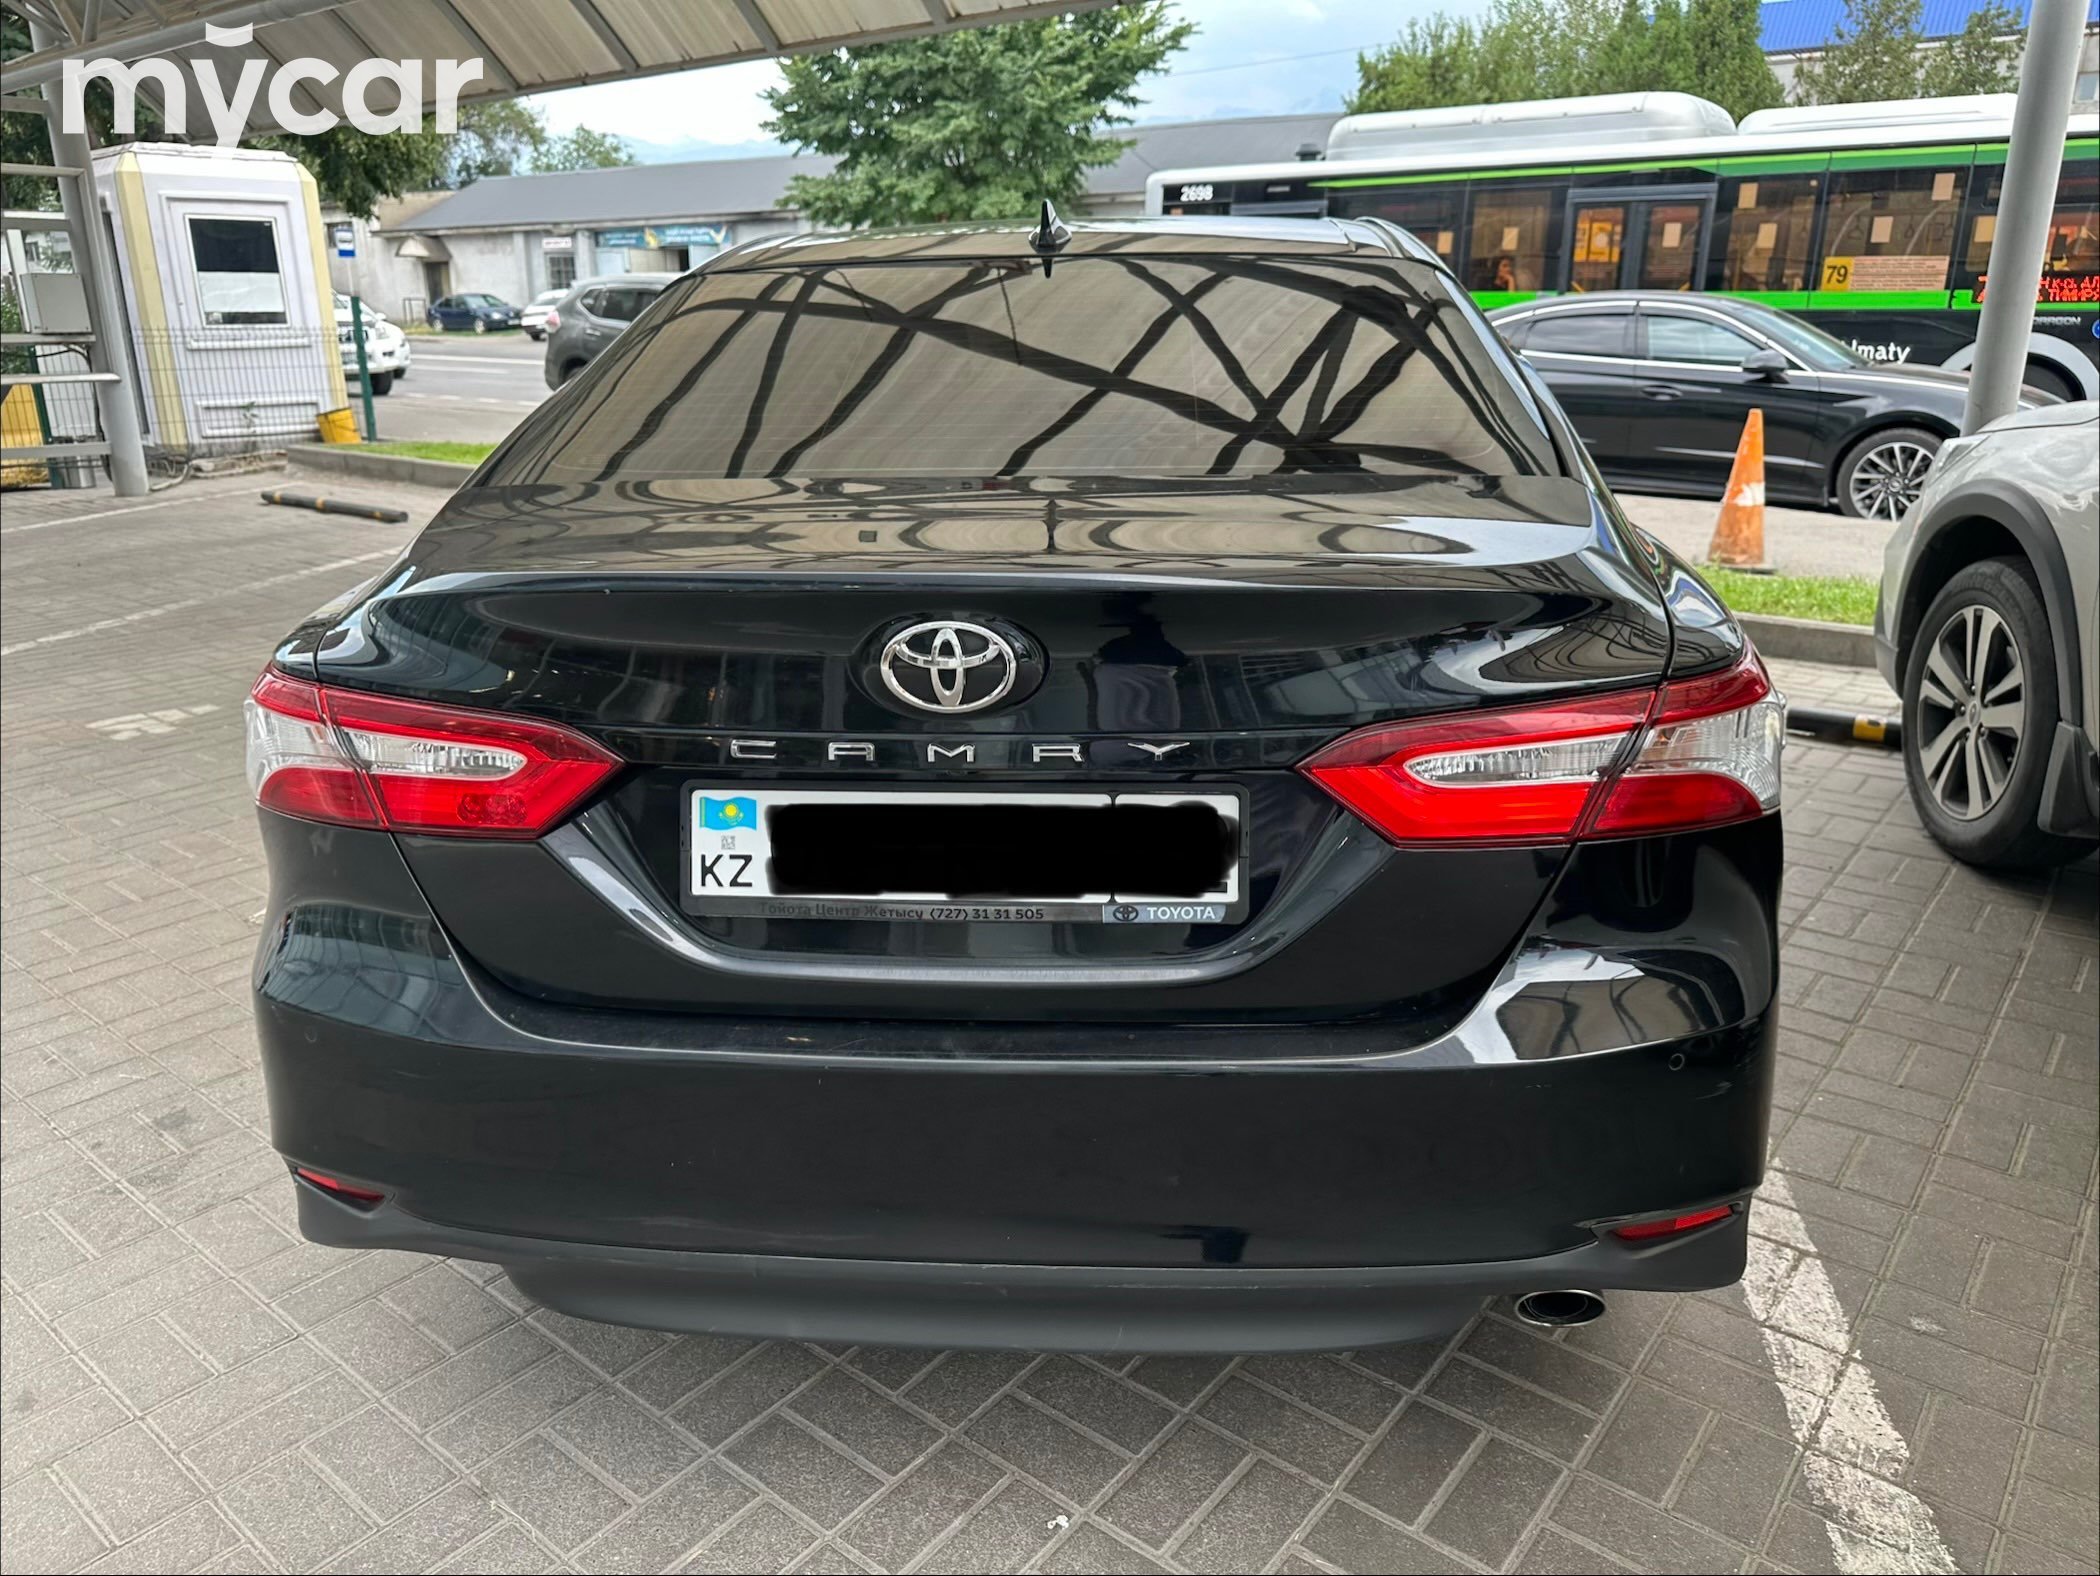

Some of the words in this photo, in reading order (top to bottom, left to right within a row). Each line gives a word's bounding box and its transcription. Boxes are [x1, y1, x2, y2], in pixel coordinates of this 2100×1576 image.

[1826, 265, 1849, 285] 79
[1851, 338, 1911, 365] lmaty
[729, 738, 1191, 763] CAMRY
[700, 854, 753, 888] KZ
[760, 902, 812, 916] Тойота
[815, 902, 862, 918] Центр
[864, 904, 924, 920] Жетысу
[929, 907, 969, 921] (727)
[972, 907, 990, 920] 31
[993, 907, 1011, 920] 31
[1014, 907, 1044, 920] 505
[1147, 905, 1216, 920] TOYOTA
